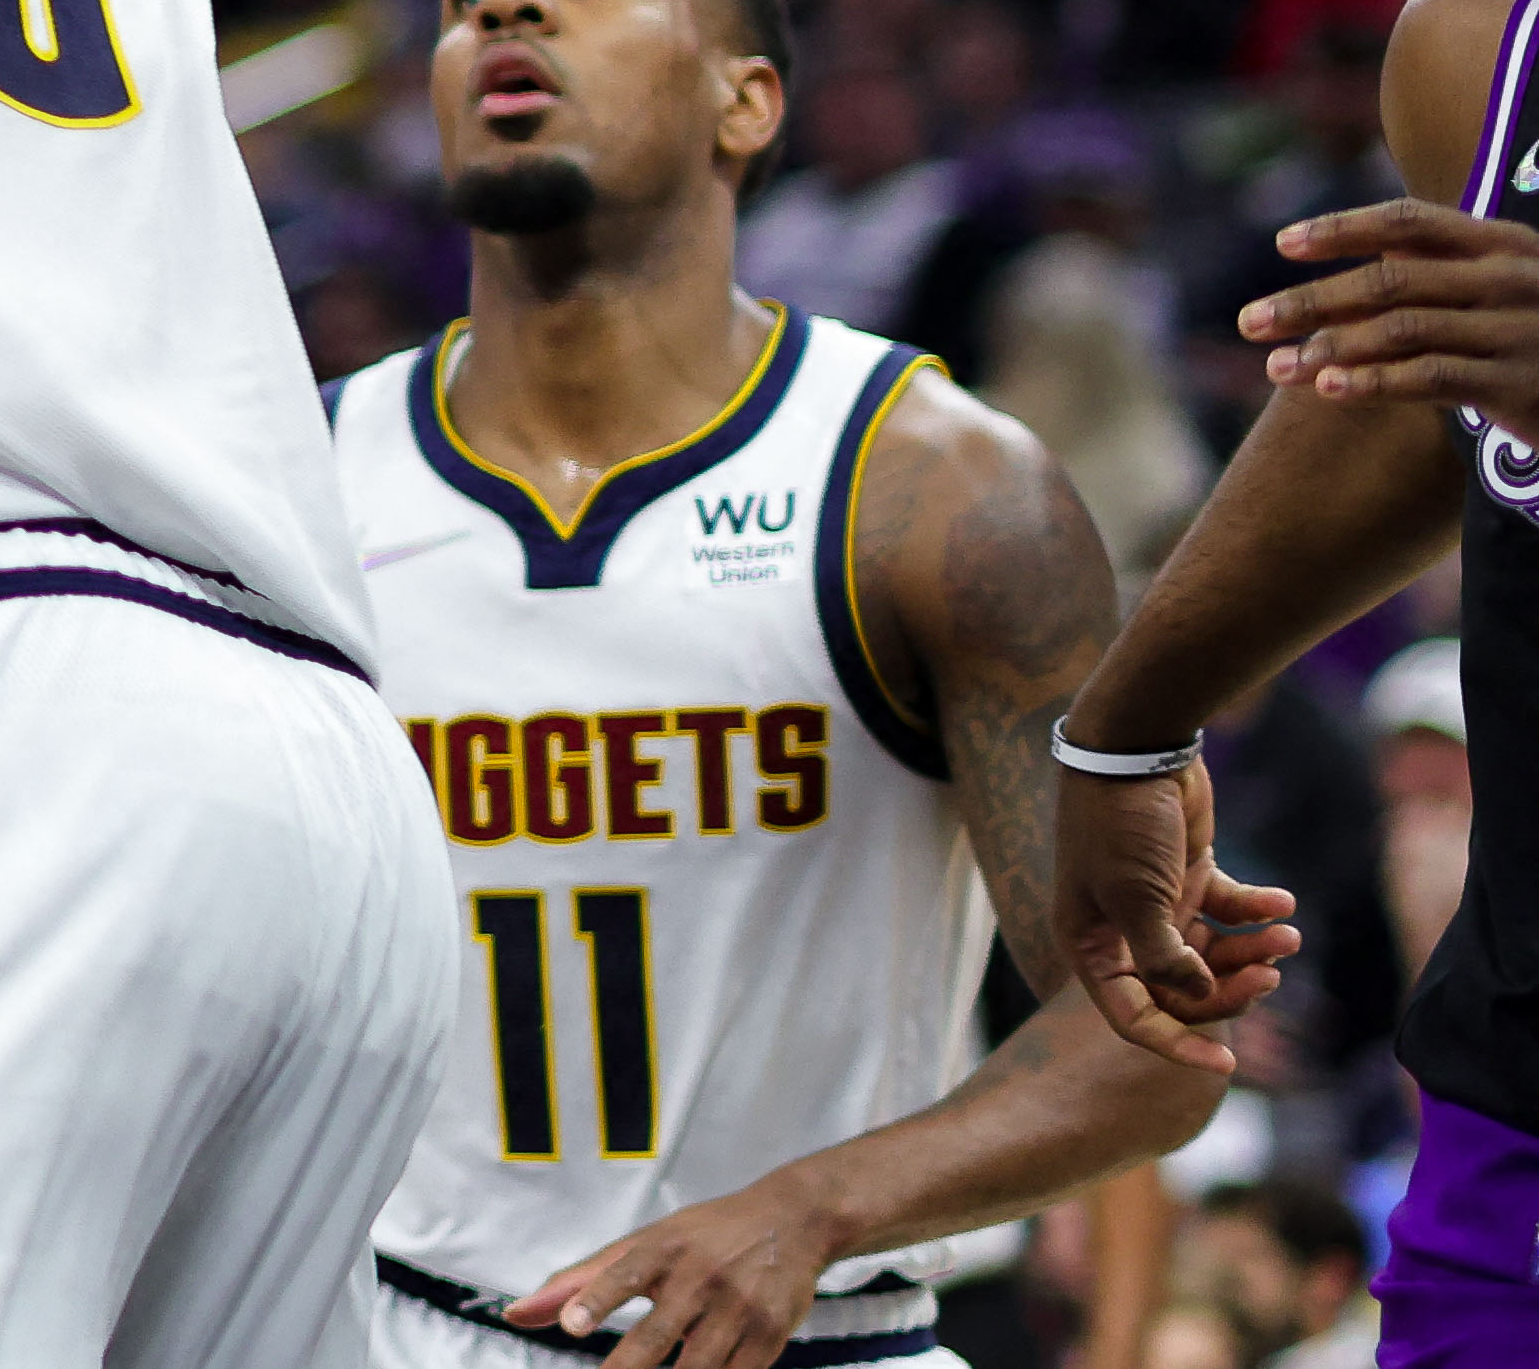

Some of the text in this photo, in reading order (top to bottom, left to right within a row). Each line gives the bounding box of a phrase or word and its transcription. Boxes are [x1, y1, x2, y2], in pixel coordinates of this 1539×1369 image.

[693, 488, 796, 535] WU
[691, 541, 795, 562] Western
[709, 565, 779, 584] Union
[468, 886, 659, 1162] 11
